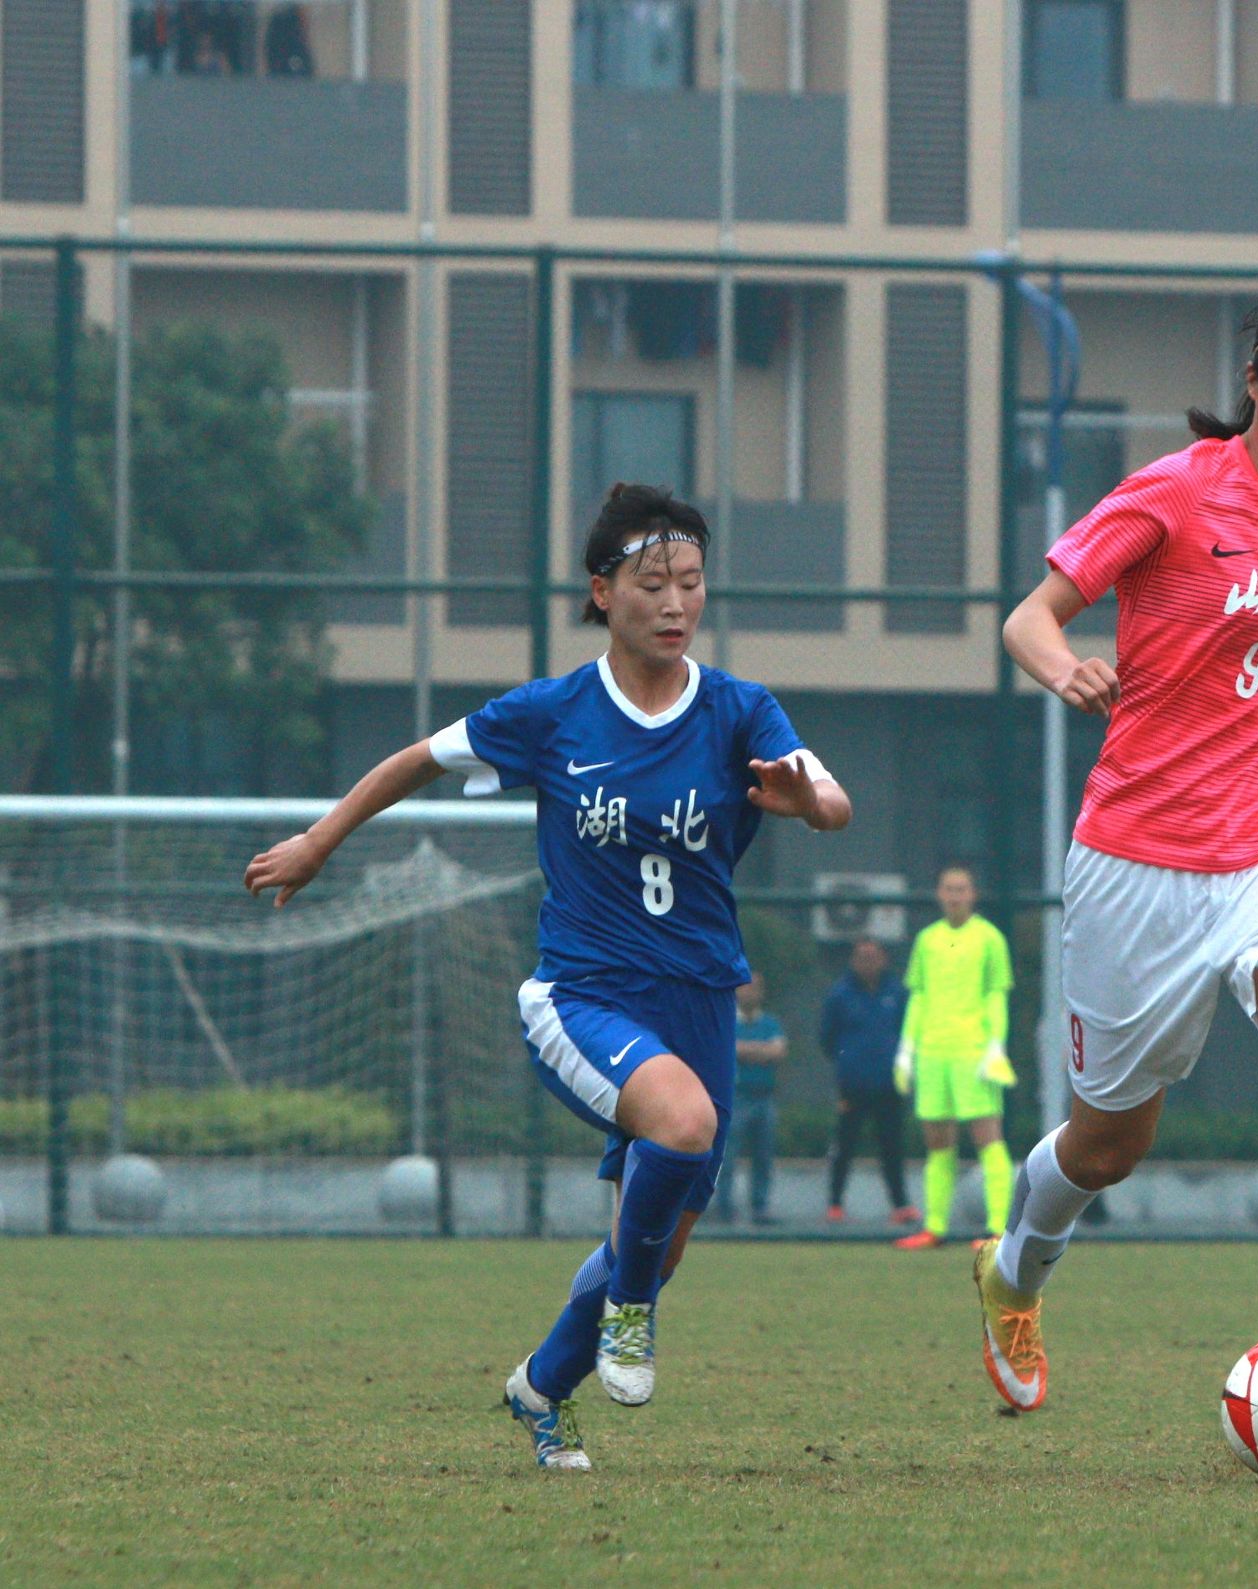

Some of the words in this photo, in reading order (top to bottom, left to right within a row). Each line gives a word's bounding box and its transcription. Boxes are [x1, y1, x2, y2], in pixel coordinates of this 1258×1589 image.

[576, 786, 709, 852] 湖北
[640, 853, 674, 916] 8
[1071, 1013, 1084, 1072] 9
